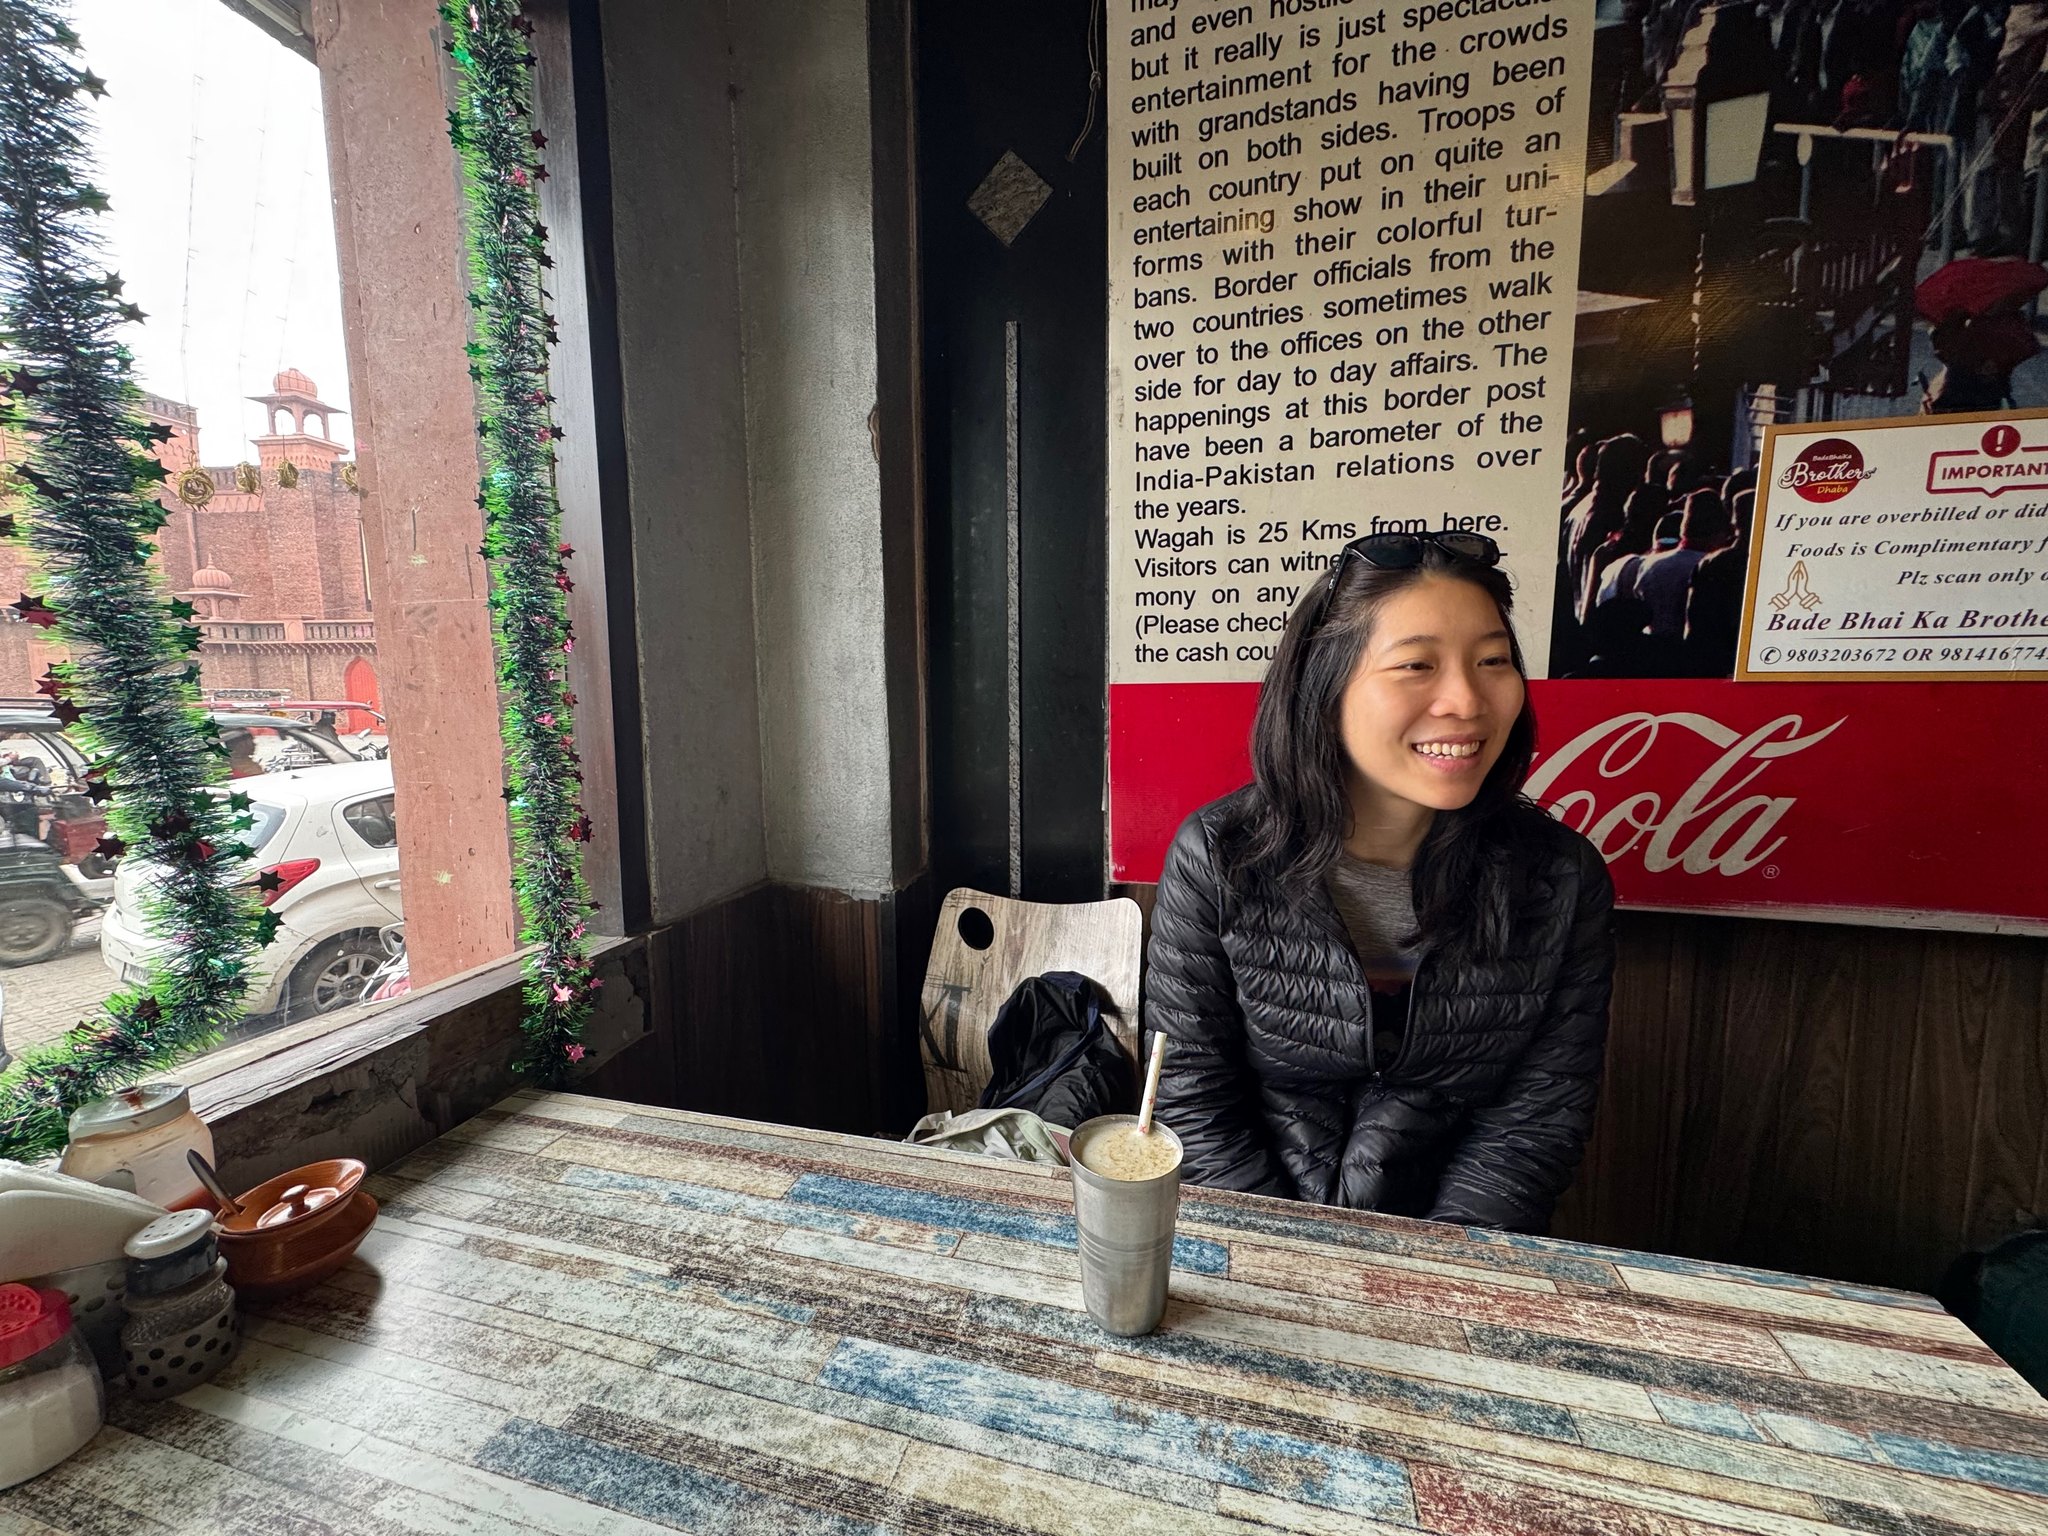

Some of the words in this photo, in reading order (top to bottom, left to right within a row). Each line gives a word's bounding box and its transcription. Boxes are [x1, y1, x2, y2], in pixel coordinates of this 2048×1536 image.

[1130, 15, 1176, 48] and
[1191, 5, 1253, 35] even
[1131, 51, 1170, 82] but
[1184, 45, 1199, 72] it
[1214, 31, 1284, 66] really
[1299, 23, 1321, 50] is
[1334, 8, 1387, 49] just
[1402, 0, 1551, 32] spectac
[1131, 59, 1313, 115] entertainment
[1331, 51, 1372, 79] for
[1391, 39, 1437, 68] the
[1459, 13, 1568, 55] crowds
[1130, 118, 1180, 148] with
[1198, 88, 1358, 143] grandstands
[1378, 71, 1470, 106] having
[1492, 55, 1566, 87] been
[1132, 151, 1183, 182] built
[1198, 148, 1229, 171] on
[1247, 131, 1302, 163] both
[1320, 120, 1398, 151] sides.
[1417, 101, 1516, 134] Troops
[1535, 85, 1568, 116] of
[1132, 183, 1191, 214] each
[1208, 169, 1302, 202] country
[1320, 155, 1362, 192] put
[1380, 153, 1414, 176] on
[1434, 136, 1504, 173] quite
[1524, 130, 1561, 155] an
[1133, 207, 1275, 246] entertaining
[1293, 195, 1363, 223] show
[1381, 185, 1404, 211] in
[1423, 172, 1487, 205] their
[1505, 162, 1560, 193] uni-
[1132, 252, 1203, 278] forms
[1221, 238, 1274, 266] with
[1294, 226, 1357, 257] their
[1376, 207, 1483, 245] colorful
[1504, 204, 1558, 229] tur-
[1134, 286, 1197, 310] bans.
[1214, 270, 1299, 300] Border
[1313, 253, 1412, 288] officials
[1428, 247, 1491, 273] from
[1509, 237, 1555, 264] the
[1133, 319, 1175, 341] two
[1192, 302, 1304, 334] countries
[1322, 285, 1468, 320] sometimes
[1488, 270, 1553, 301] walk
[1134, 350, 1186, 372] over
[1195, 343, 1219, 366] to
[1229, 338, 1271, 362] the
[1280, 330, 1363, 357] offices
[1375, 326, 1408, 347] on
[1421, 316, 1465, 342] the
[1478, 308, 1553, 336] other
[1134, 377, 1182, 403] side
[1192, 374, 1226, 397] for
[1236, 369, 1282, 396] day
[1293, 365, 1318, 388] to
[1329, 359, 1378, 387] day
[1389, 349, 1479, 378] affairs.
[1492, 342, 1548, 368] The
[1135, 403, 1271, 436] happenings
[1285, 396, 1310, 420] at
[1322, 391, 1368, 417] this
[1384, 383, 1472, 411] border
[1486, 375, 1547, 409] post
[1135, 441, 1191, 463] have
[1205, 435, 1263, 458] been
[1278, 434, 1294, 452] a
[1309, 419, 1443, 450] barometer
[1457, 412, 1486, 438] of
[1499, 410, 1543, 435] the
[1135, 461, 1315, 493] India-Pakistan
[1336, 451, 1455, 479] relations
[1476, 447, 1543, 469] over
[1777, 461, 1877, 490] Brothers
[1817, 484, 1849, 495] Dhaba
[1133, 498, 1170, 521] the
[1176, 498, 1246, 523] years.
[1134, 525, 1214, 553] Wagah
[1227, 523, 1246, 545] is
[1258, 521, 1289, 544] 25
[1302, 518, 1357, 542] Kms
[1369, 516, 1427, 534] from
[1443, 512, 1508, 533] here.
[1775, 513, 1797, 532] If
[1795, 515, 1832, 531] you
[1838, 513, 1871, 525] are
[1876, 505, 1982, 524] overbilled
[1985, 508, 2009, 520] or
[1134, 556, 1218, 579] Visitors
[1227, 557, 1270, 575] can
[1280, 550, 1342, 572] witne
[1786, 541, 1845, 558] Foods
[1850, 541, 1867, 556] is
[1874, 538, 2034, 558] Complimentary
[2034, 535, 2048, 553] f
[1135, 589, 1197, 611] mony
[1211, 587, 1240, 605] on
[1256, 586, 1300, 607] any
[1896, 570, 1928, 586] Plz
[1933, 572, 1982, 584] scan
[1987, 567, 2035, 586] only
[1135, 614, 1220, 641] (Please
[1765, 612, 1832, 631] Bade
[1838, 611, 1905, 630] Bhai
[1909, 610, 1949, 629] Ka
[1956, 608, 2048, 629] Brothe
[1134, 643, 1169, 663] the
[1175, 641, 1229, 663] cash
[1236, 645, 1277, 662] cou
[1785, 648, 1897, 662] 9803203672
[1902, 648, 1933, 661] OR
[1940, 647, 2048, 662] 981416774
[1515, 711, 1848, 876] Cola
